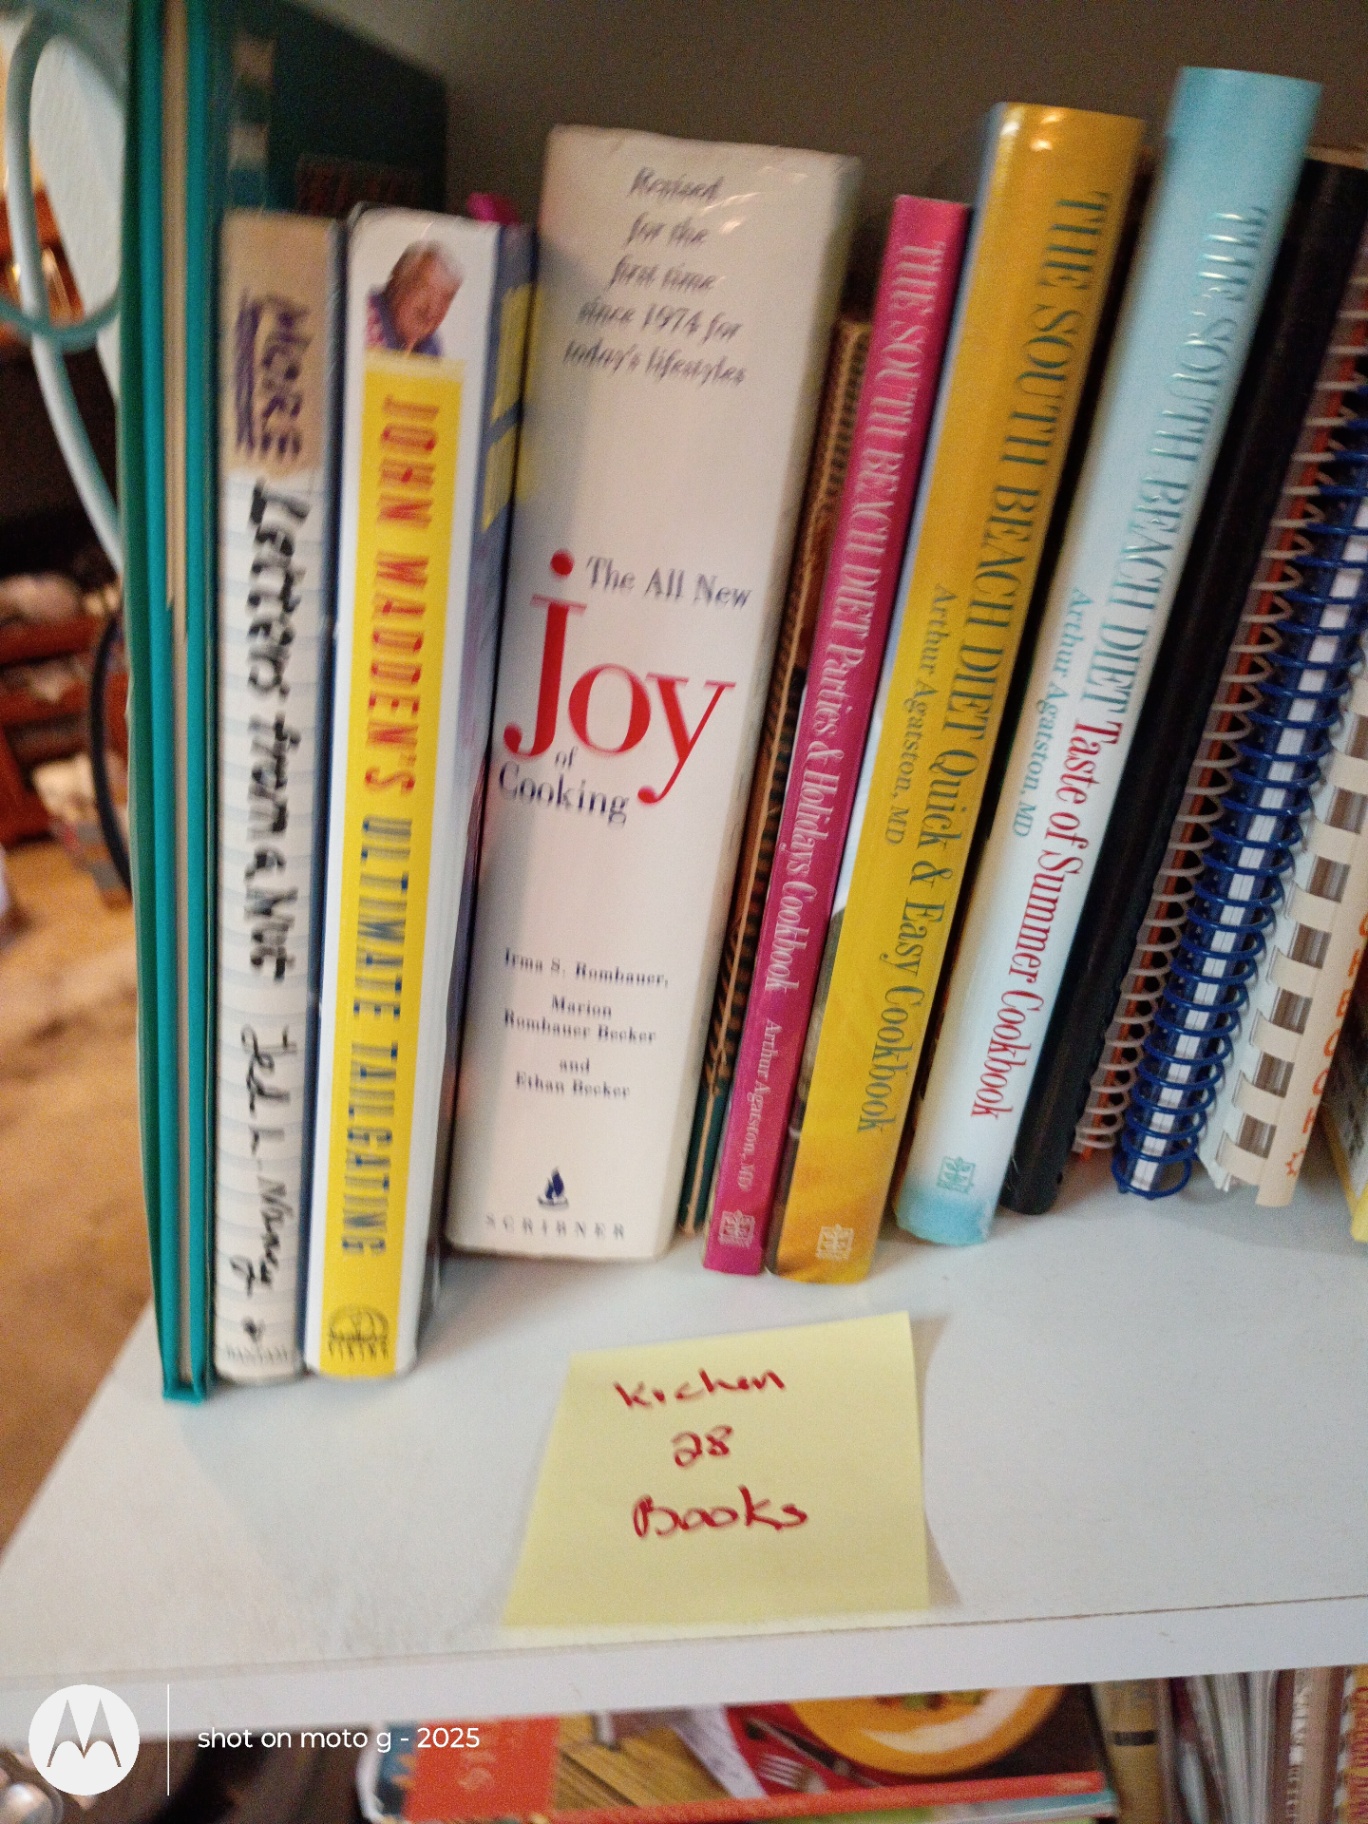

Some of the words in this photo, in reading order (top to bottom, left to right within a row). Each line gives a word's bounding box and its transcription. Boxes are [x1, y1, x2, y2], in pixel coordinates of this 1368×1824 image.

[628, 167, 724, 200] Revised
[625, 212, 664, 248] for
[670, 217, 709, 247] the
[1037, 190, 1109, 291] THE
[1196, 205, 1268, 302] THE
[608, 254, 659, 290] first
[661, 262, 717, 291] time
[888, 240, 946, 315] THE
[578, 297, 636, 324] since
[641, 303, 703, 336] 1974
[702, 311, 743, 346] for
[563, 338, 641, 374] today's
[644, 346, 747, 387] lifestyles
[865, 319, 930, 438] SOUTH
[1001, 302, 1083, 466] SOUTH
[1149, 308, 1238, 464] SOUTH
[378, 394, 441, 530] JOHN
[844, 447, 904, 558] BEACH
[586, 556, 637, 590] The
[645, 567, 685, 599] All
[693, 573, 752, 610] New
[966, 484, 1041, 629] BEACH
[1106, 476, 1190, 613] BEACH
[830, 563, 881, 644] DIET
[915, 584, 958, 673] Arthur
[1056, 586, 1094, 680] Arthur
[364, 551, 430, 793] MADDEN'S
[814, 644, 866, 738] Parties
[941, 642, 1005, 741] DIET
[1080, 619, 1154, 722] DIET
[500, 761, 629, 826] Cooking
[555, 746, 578, 769] of
[807, 740, 846, 771] &
[1056, 718, 1123, 805] Taste
[779, 771, 840, 876] Holidays
[884, 804, 909, 845] MD
[916, 747, 980, 850] Quick
[1012, 801, 1038, 839] MD
[1045, 808, 1088, 855] of
[909, 859, 954, 887] &
[352, 815, 412, 1019] ULTIMATE
[764, 880, 819, 993] Cookbook
[879, 898, 946, 978] Easy
[1009, 854, 1084, 986] Summer
[504, 947, 544, 973] Irma
[550, 958, 566, 974] S.
[575, 961, 669, 988] Rombauer,
[551, 995, 613, 1018] Marion
[504, 1008, 590, 1038] Rombauer
[597, 1023, 657, 1045] Becker
[559, 1056, 590, 1074] and
[756, 1017, 783, 1082] Arthur
[857, 985, 925, 1133] Cookbook
[970, 989, 1046, 1120] Cookbook
[516, 1070, 565, 1094] Ethan
[572, 1078, 631, 1100] Becker
[341, 1042, 399, 1255] TAILGATING
[736, 1161, 755, 1192] MD
[485, 1211, 626, 1240] SCRIBNER
[671, 1424, 734, 1468] 28
[632, 1484, 809, 1539] Books
